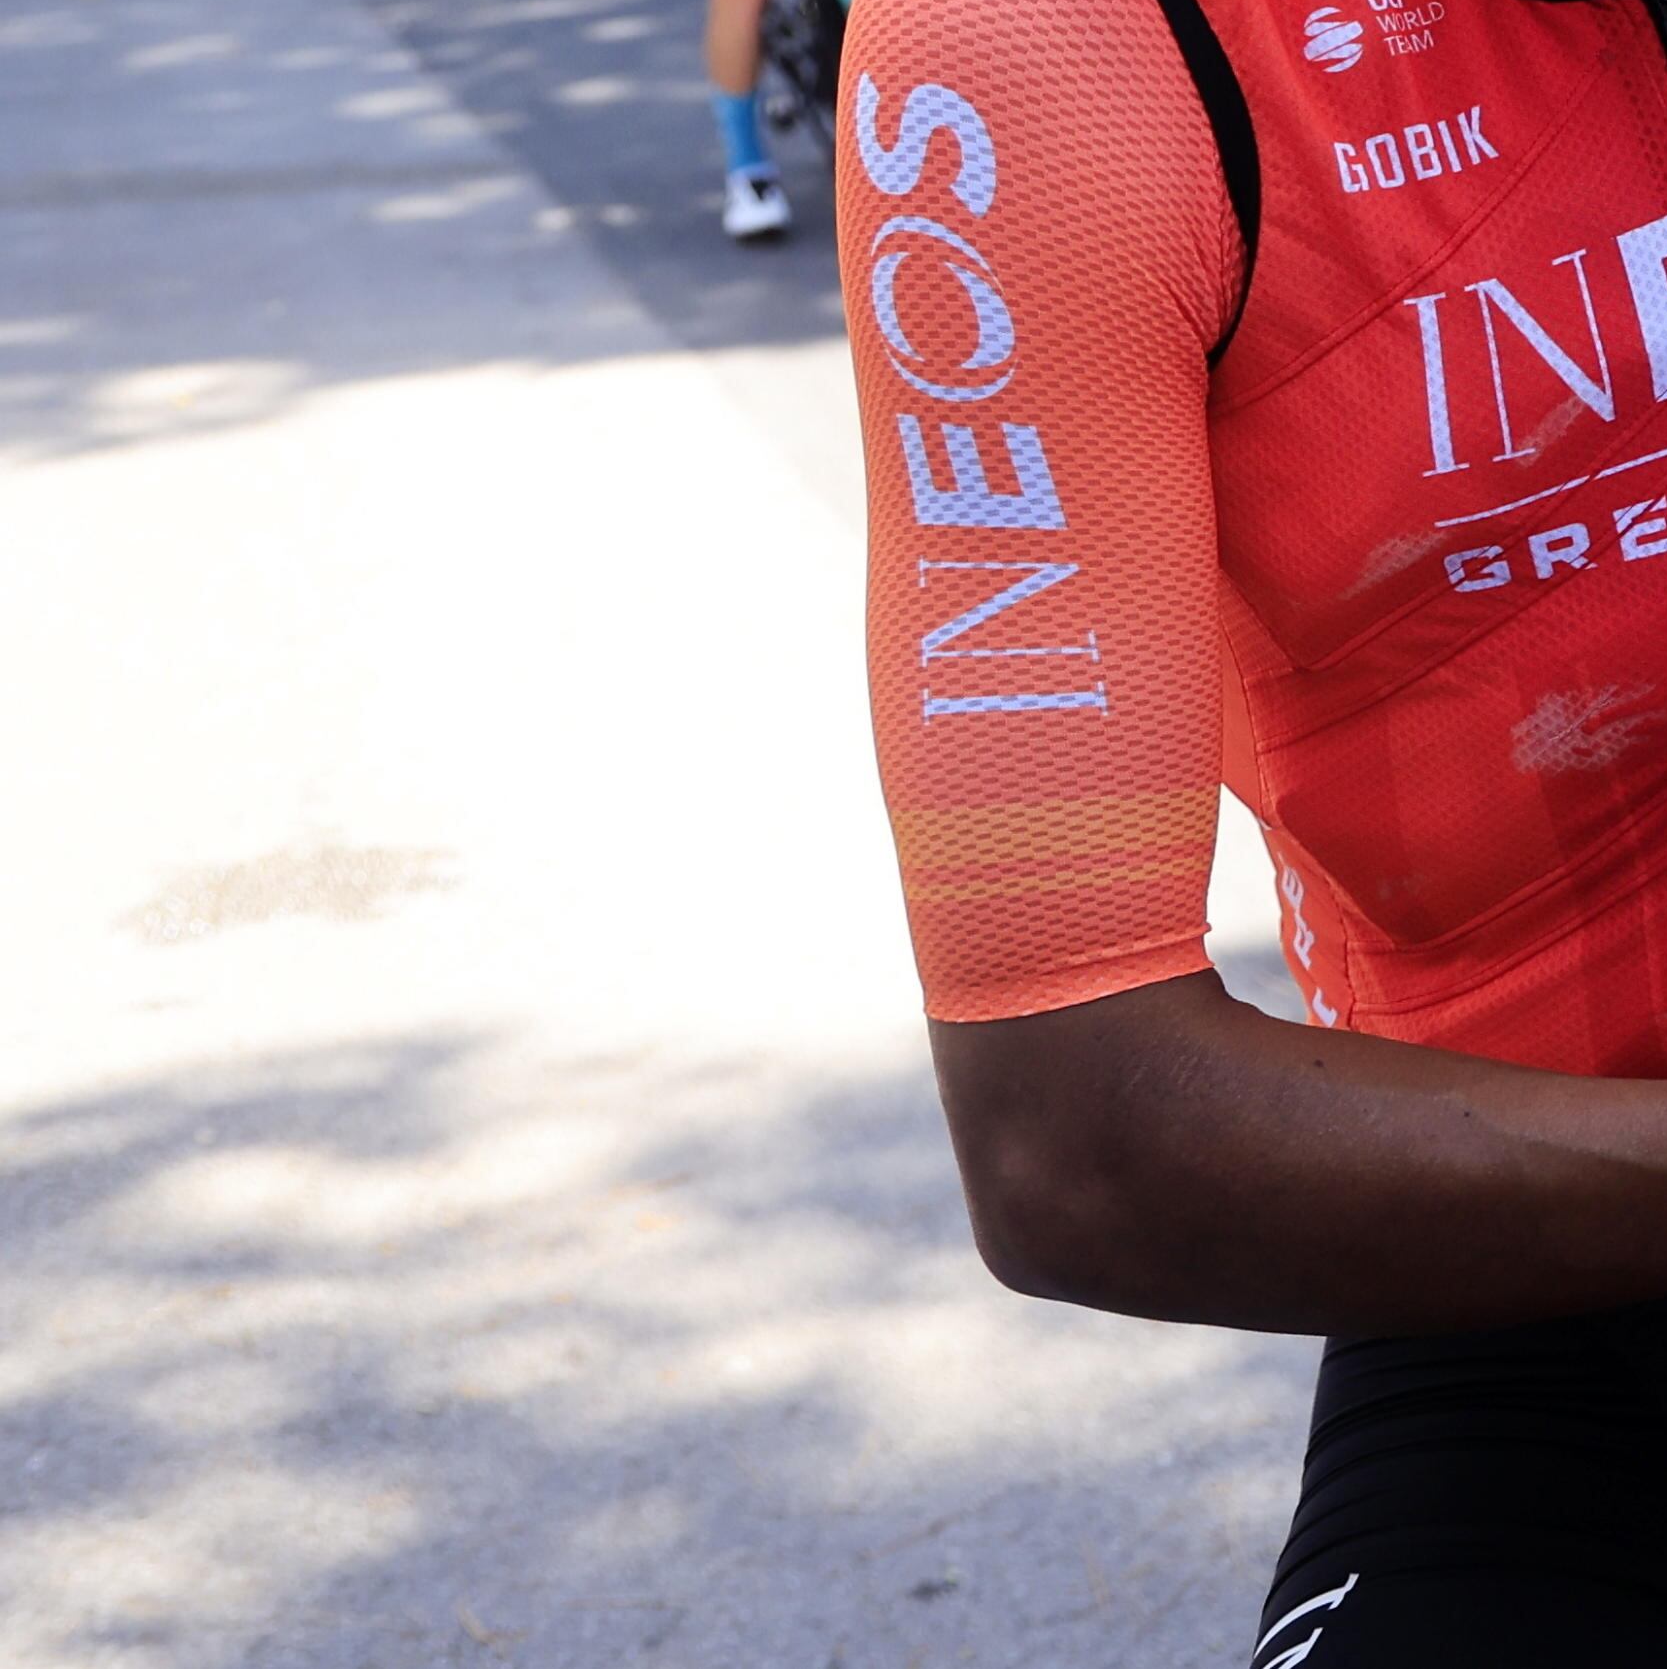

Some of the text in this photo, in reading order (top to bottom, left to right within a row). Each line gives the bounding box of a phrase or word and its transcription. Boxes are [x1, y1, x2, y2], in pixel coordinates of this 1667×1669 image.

[1375, 1, 1445, 33] WORLD
[1383, 29, 1435, 56] TEAM
[1333, 104, 1499, 193] GOBIK
[856, 71, 1109, 726] INEOS
